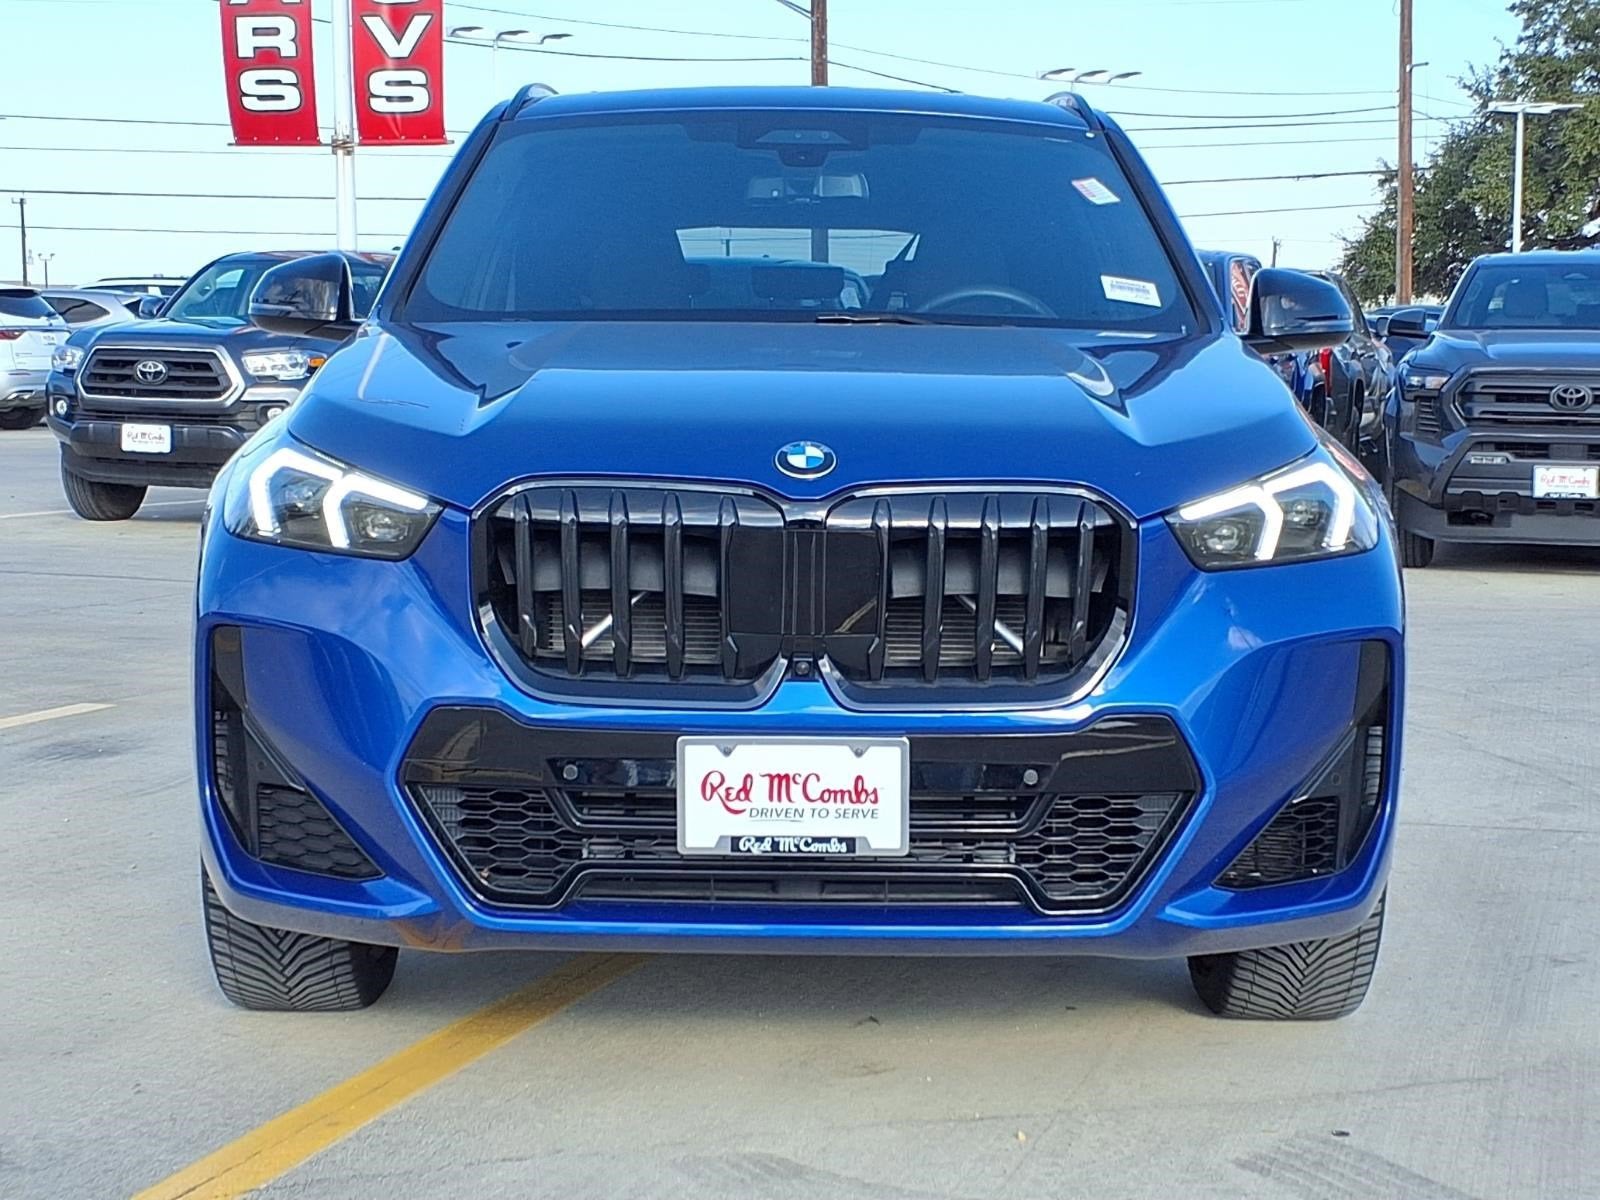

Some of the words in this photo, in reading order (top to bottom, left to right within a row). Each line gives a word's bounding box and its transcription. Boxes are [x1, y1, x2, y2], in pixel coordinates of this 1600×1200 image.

[228, 0, 303, 111] RS
[360, 0, 434, 113] VS
[701, 770, 753, 815] Red
[749, 807, 804, 818] DRIVEN
[810, 808, 830, 819] TO
[834, 808, 879, 819] SERVE
[738, 837, 772, 853] Red
